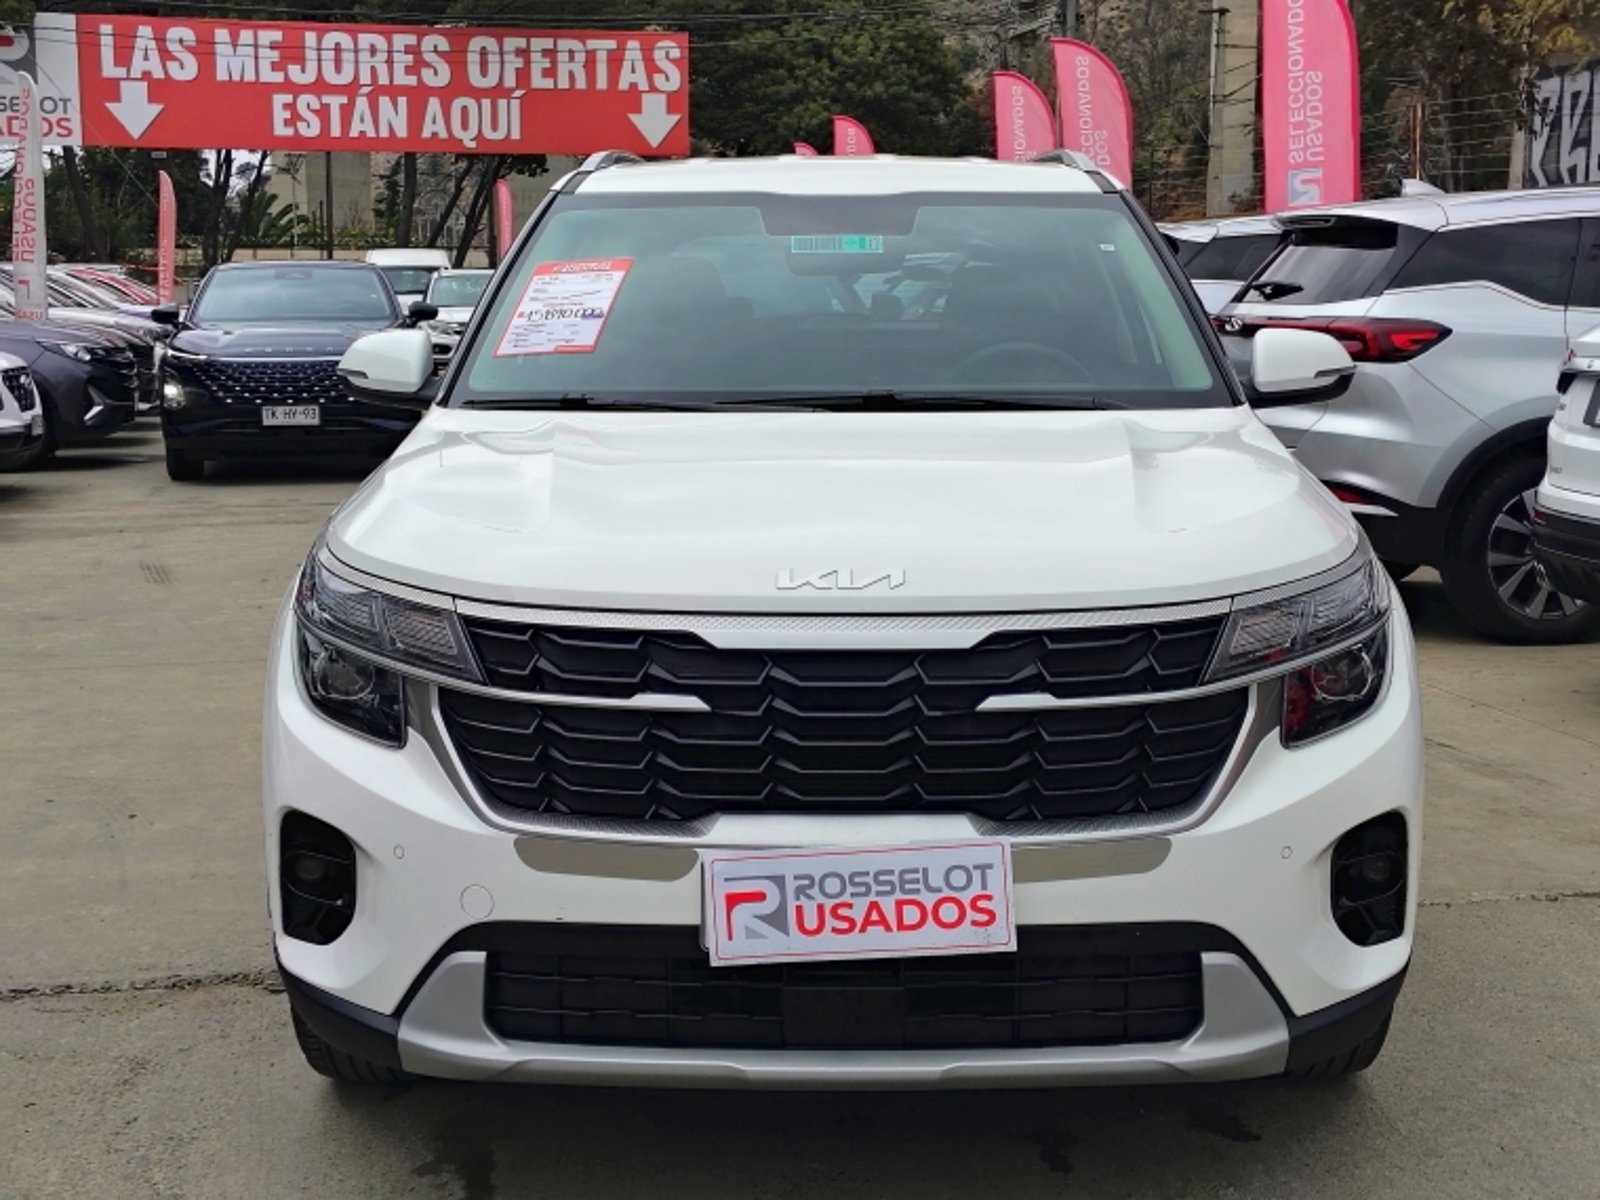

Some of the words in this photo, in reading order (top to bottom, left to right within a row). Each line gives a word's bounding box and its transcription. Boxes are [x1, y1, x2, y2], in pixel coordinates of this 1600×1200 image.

[99, 24, 198, 81] LAS
[214, 28, 452, 87] MEJORES
[467, 35, 681, 92] OFERTAS
[272, 86, 408, 138] ESTÁN
[421, 90, 527, 148] AQUÍ
[775, 568, 906, 590] KIA
[793, 863, 994, 902] ROSSELOT
[795, 894, 997, 936] USADOS
